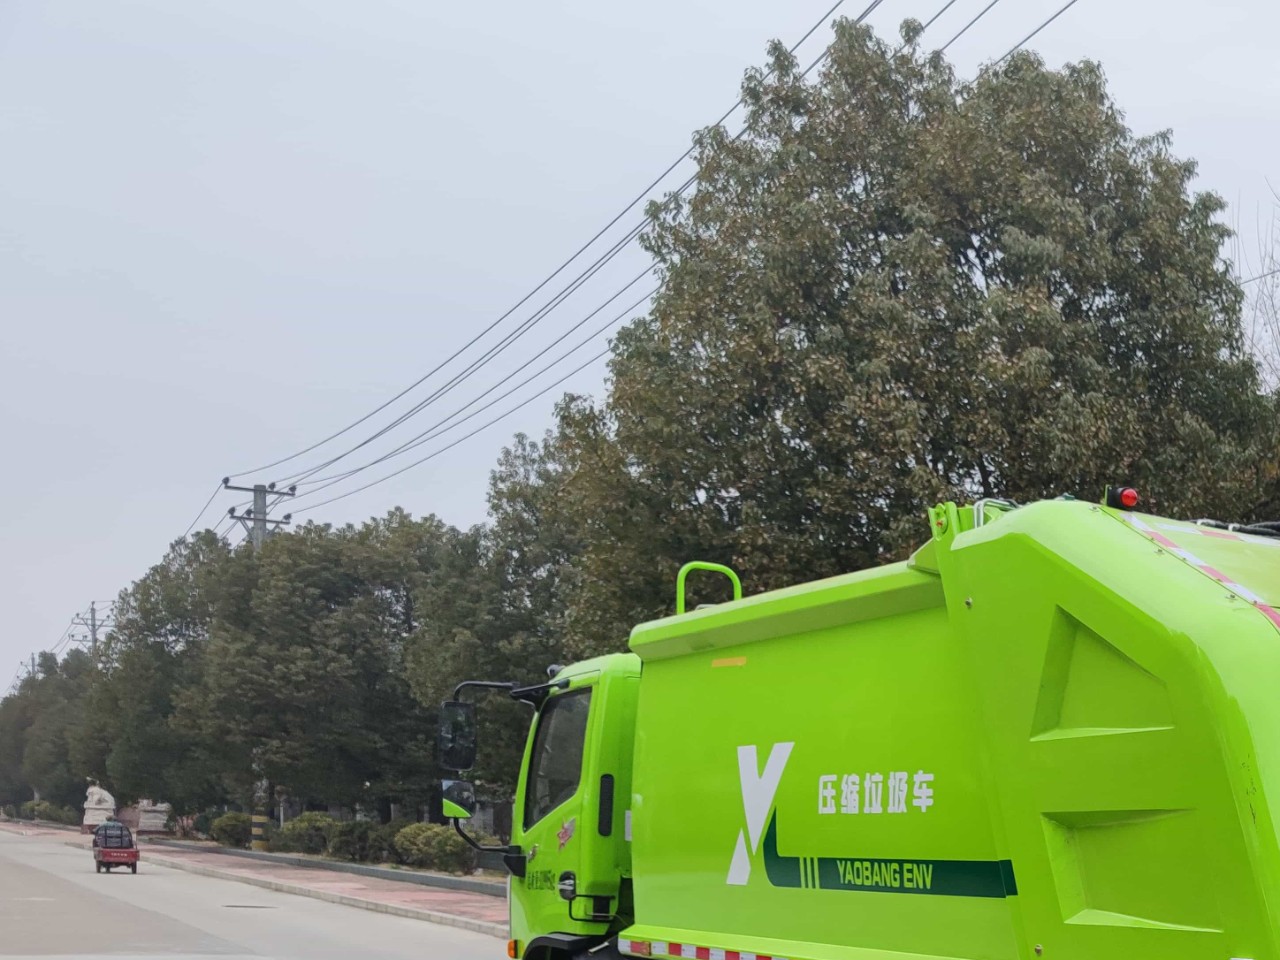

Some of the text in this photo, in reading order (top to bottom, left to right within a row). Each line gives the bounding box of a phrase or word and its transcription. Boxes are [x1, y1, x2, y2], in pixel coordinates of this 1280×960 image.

[818, 770, 935, 814] 压缩垃圾车
[836, 860, 933, 889] YAOBANG ENV
